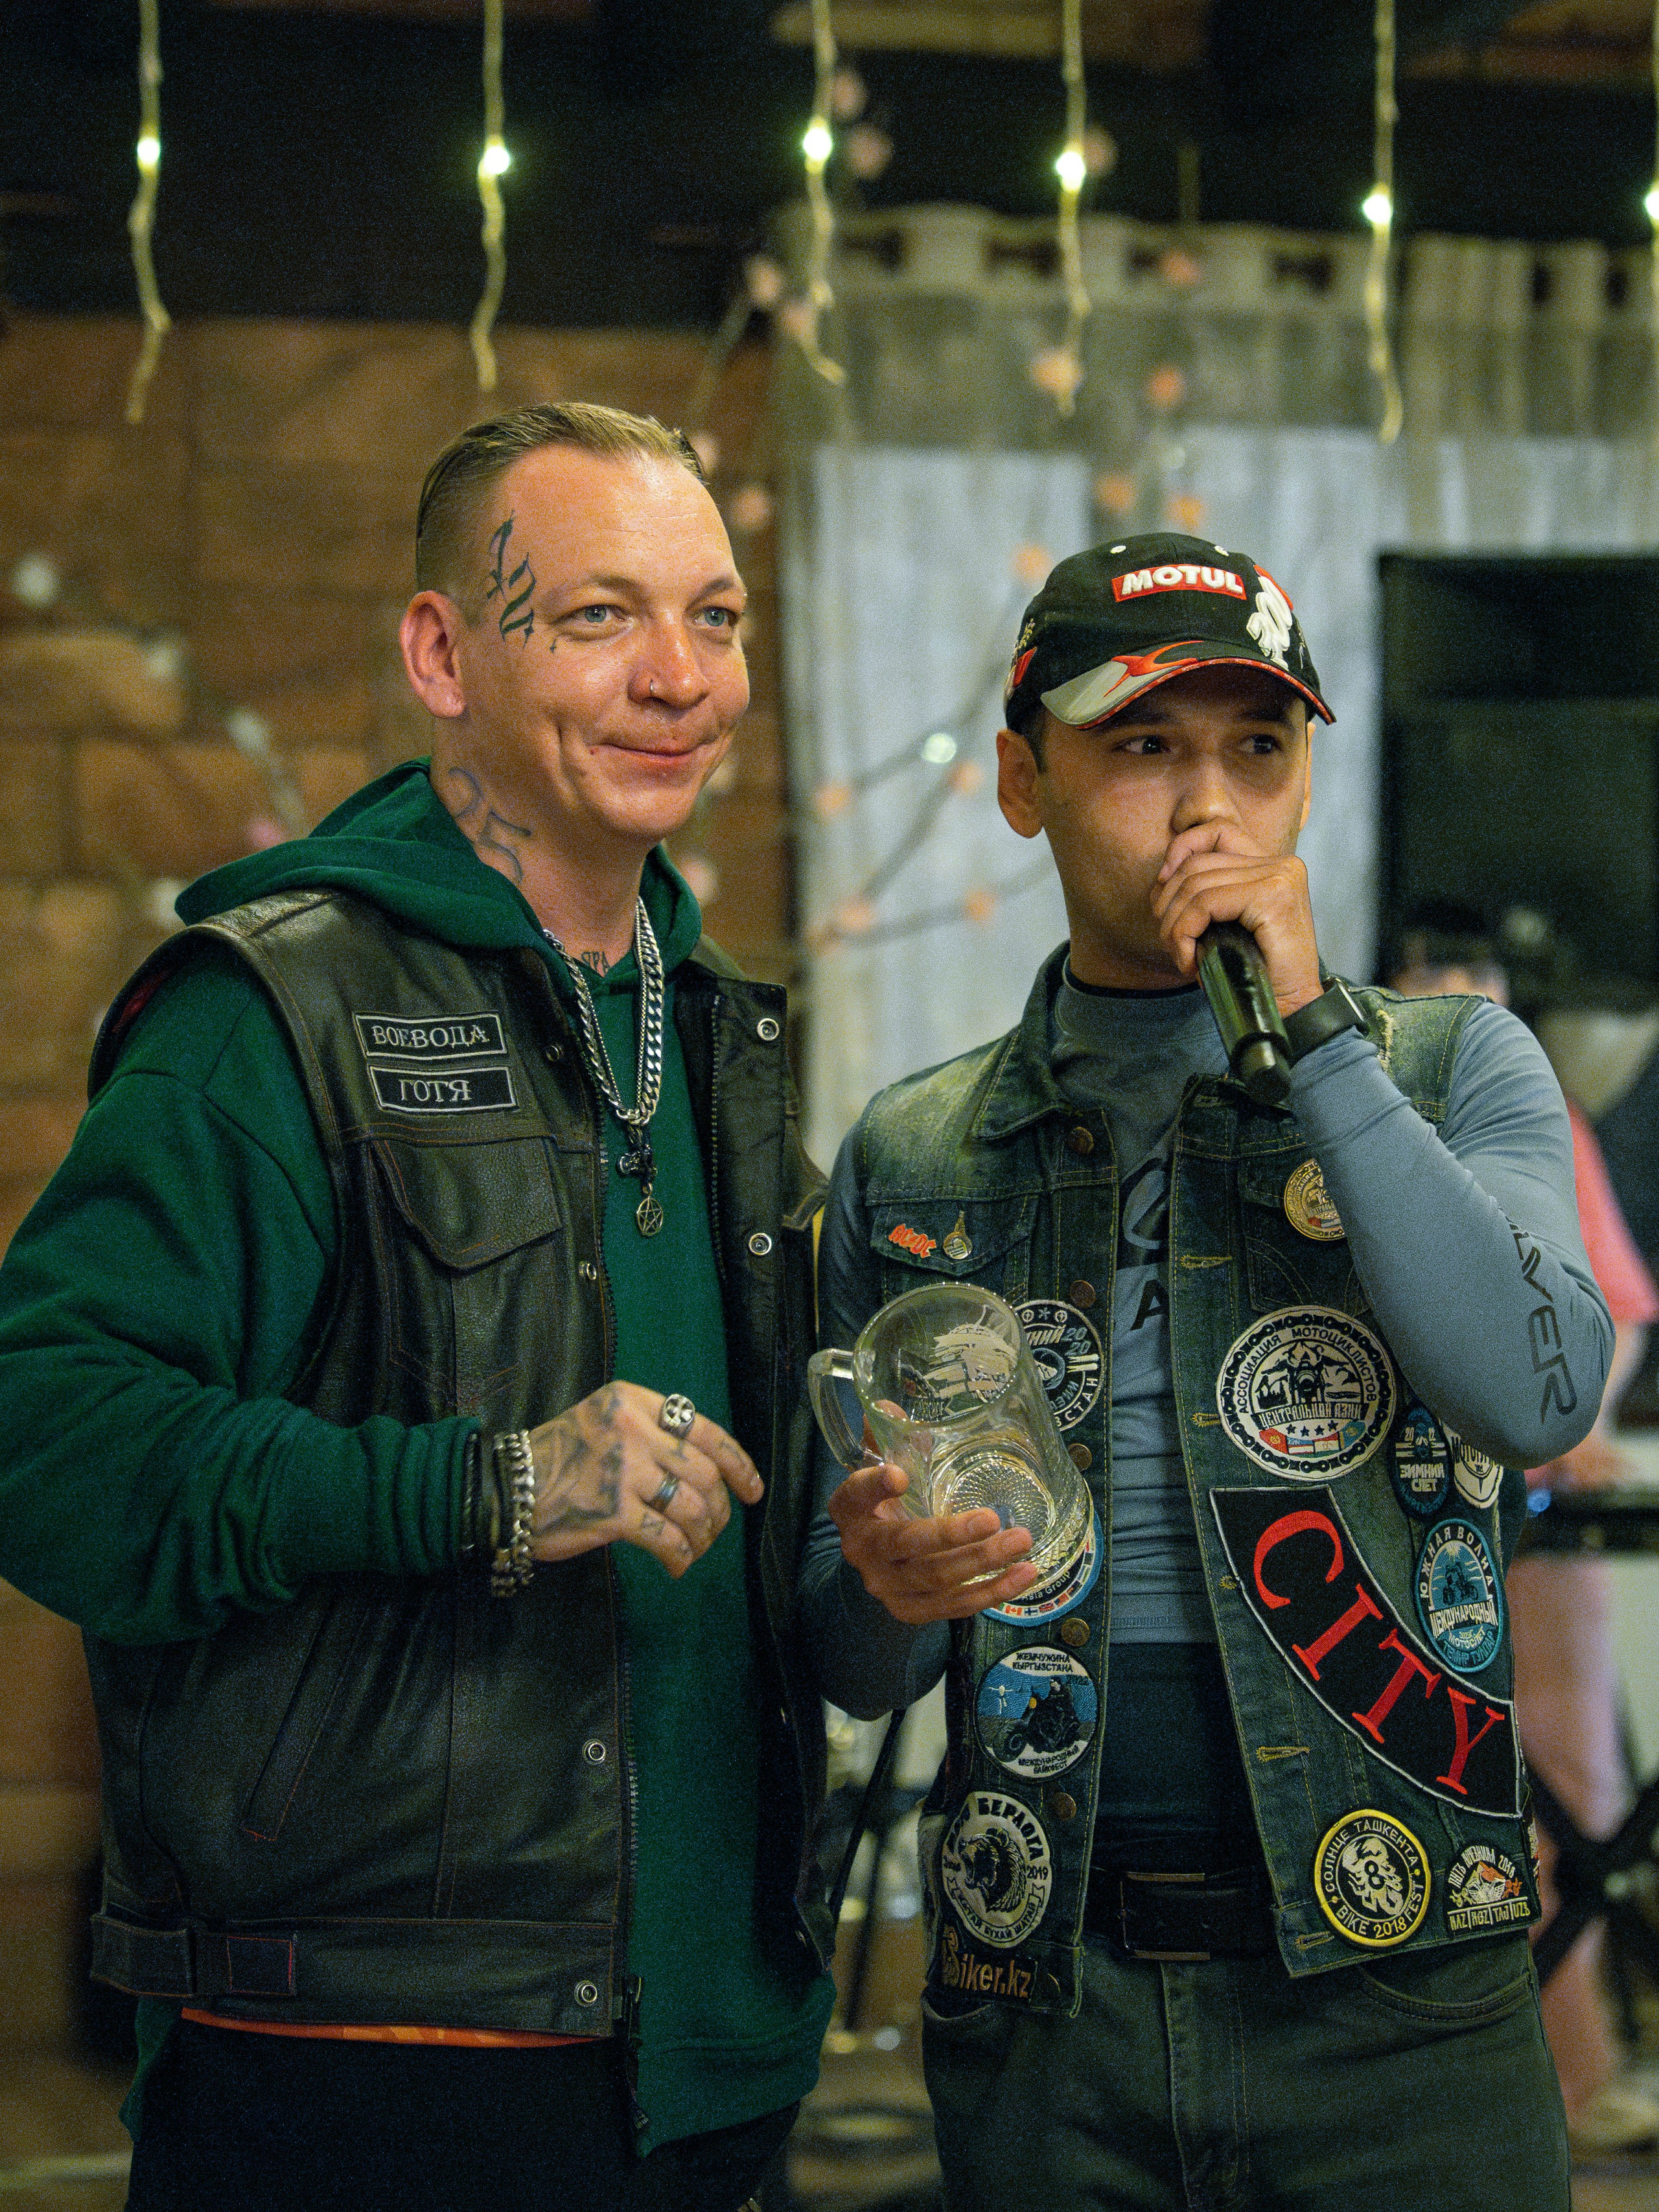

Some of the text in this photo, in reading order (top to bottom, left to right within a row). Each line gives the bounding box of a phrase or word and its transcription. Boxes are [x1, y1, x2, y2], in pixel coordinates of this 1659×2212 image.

[1121, 565, 1244, 595] MOTUL
[372, 1024, 490, 1048] ВОЕВОДА
[399, 1079, 472, 1102] ГОТЯ
[1236, 1327, 1377, 1414] АССОЦИАЦИЯ МОТОЦИКЛИСТОВ
[1400, 1461, 1445, 1479] ЗИМНИЙ
[1044, 1570, 1071, 1594] Group
[1420, 1525, 1494, 1599] ЮЖНАЯ ВОЛНА
[1429, 1600, 1498, 1640] МЕЖДУНАРОДНЫЙ
[1253, 1510, 1505, 1795] CITY
[977, 1796, 1045, 1861] БЕРЛОГА
[1324, 1819, 1419, 1892] СОЛНЦЕ ТАШКЕНТА
[1363, 1859, 1385, 1890] 8
[1335, 1880, 1426, 1939] BIKE 2018 FEST
